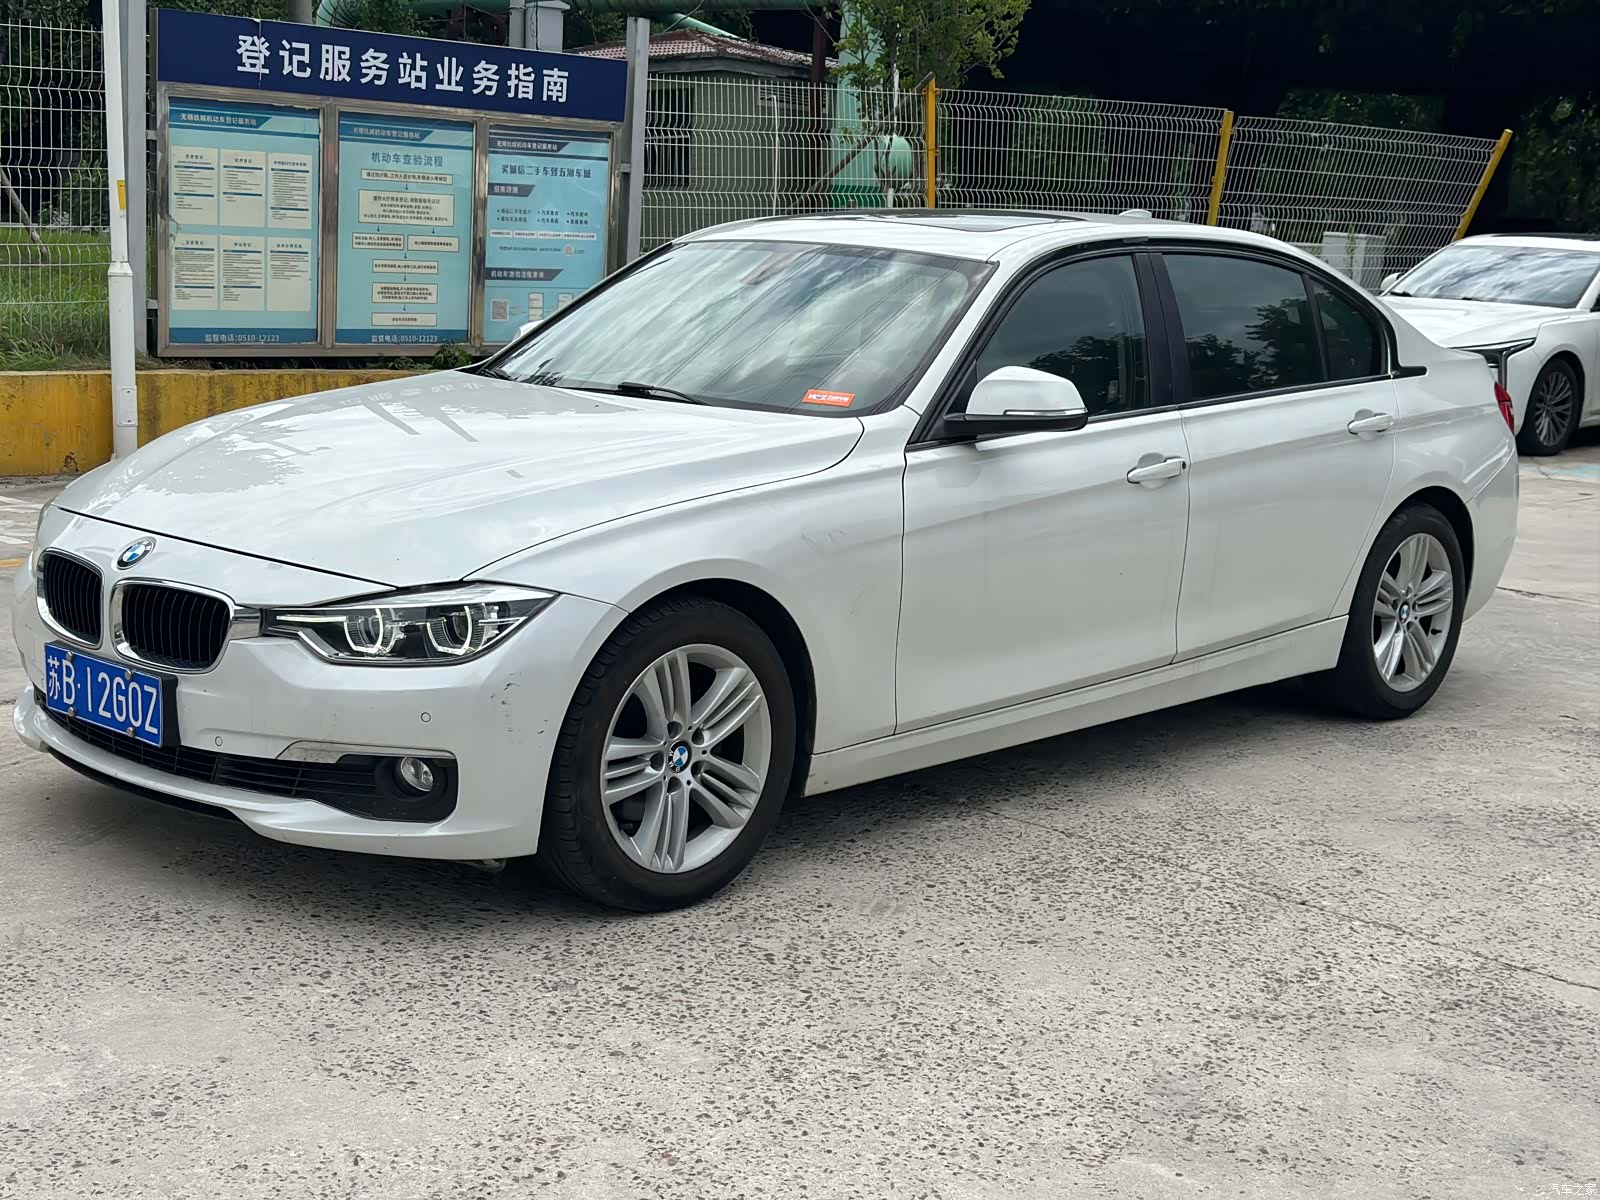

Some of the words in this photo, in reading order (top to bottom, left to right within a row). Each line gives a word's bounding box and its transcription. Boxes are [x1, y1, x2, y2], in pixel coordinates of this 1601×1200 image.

[236, 34, 570, 104] 登记服务站业务指南
[371, 151, 444, 168] 机动车查验流程
